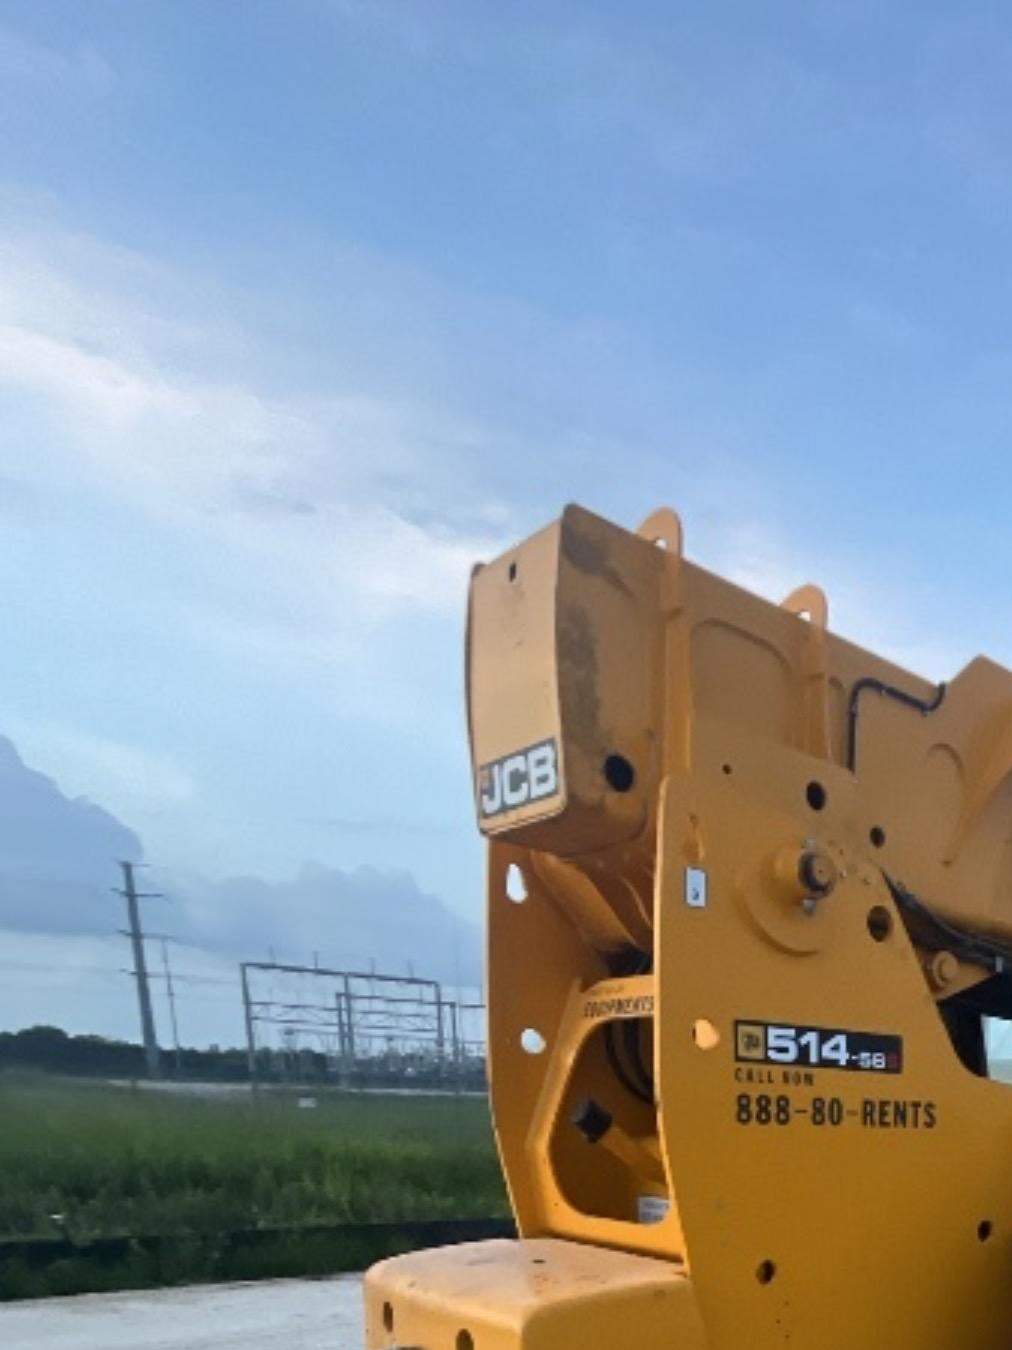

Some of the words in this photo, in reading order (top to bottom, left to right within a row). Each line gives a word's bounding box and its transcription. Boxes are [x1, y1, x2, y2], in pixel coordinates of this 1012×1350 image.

[482, 742, 556, 814] JCB
[734, 1067, 775, 1084] CALL
[736, 1094, 937, 1129] 888-80-RENTS
